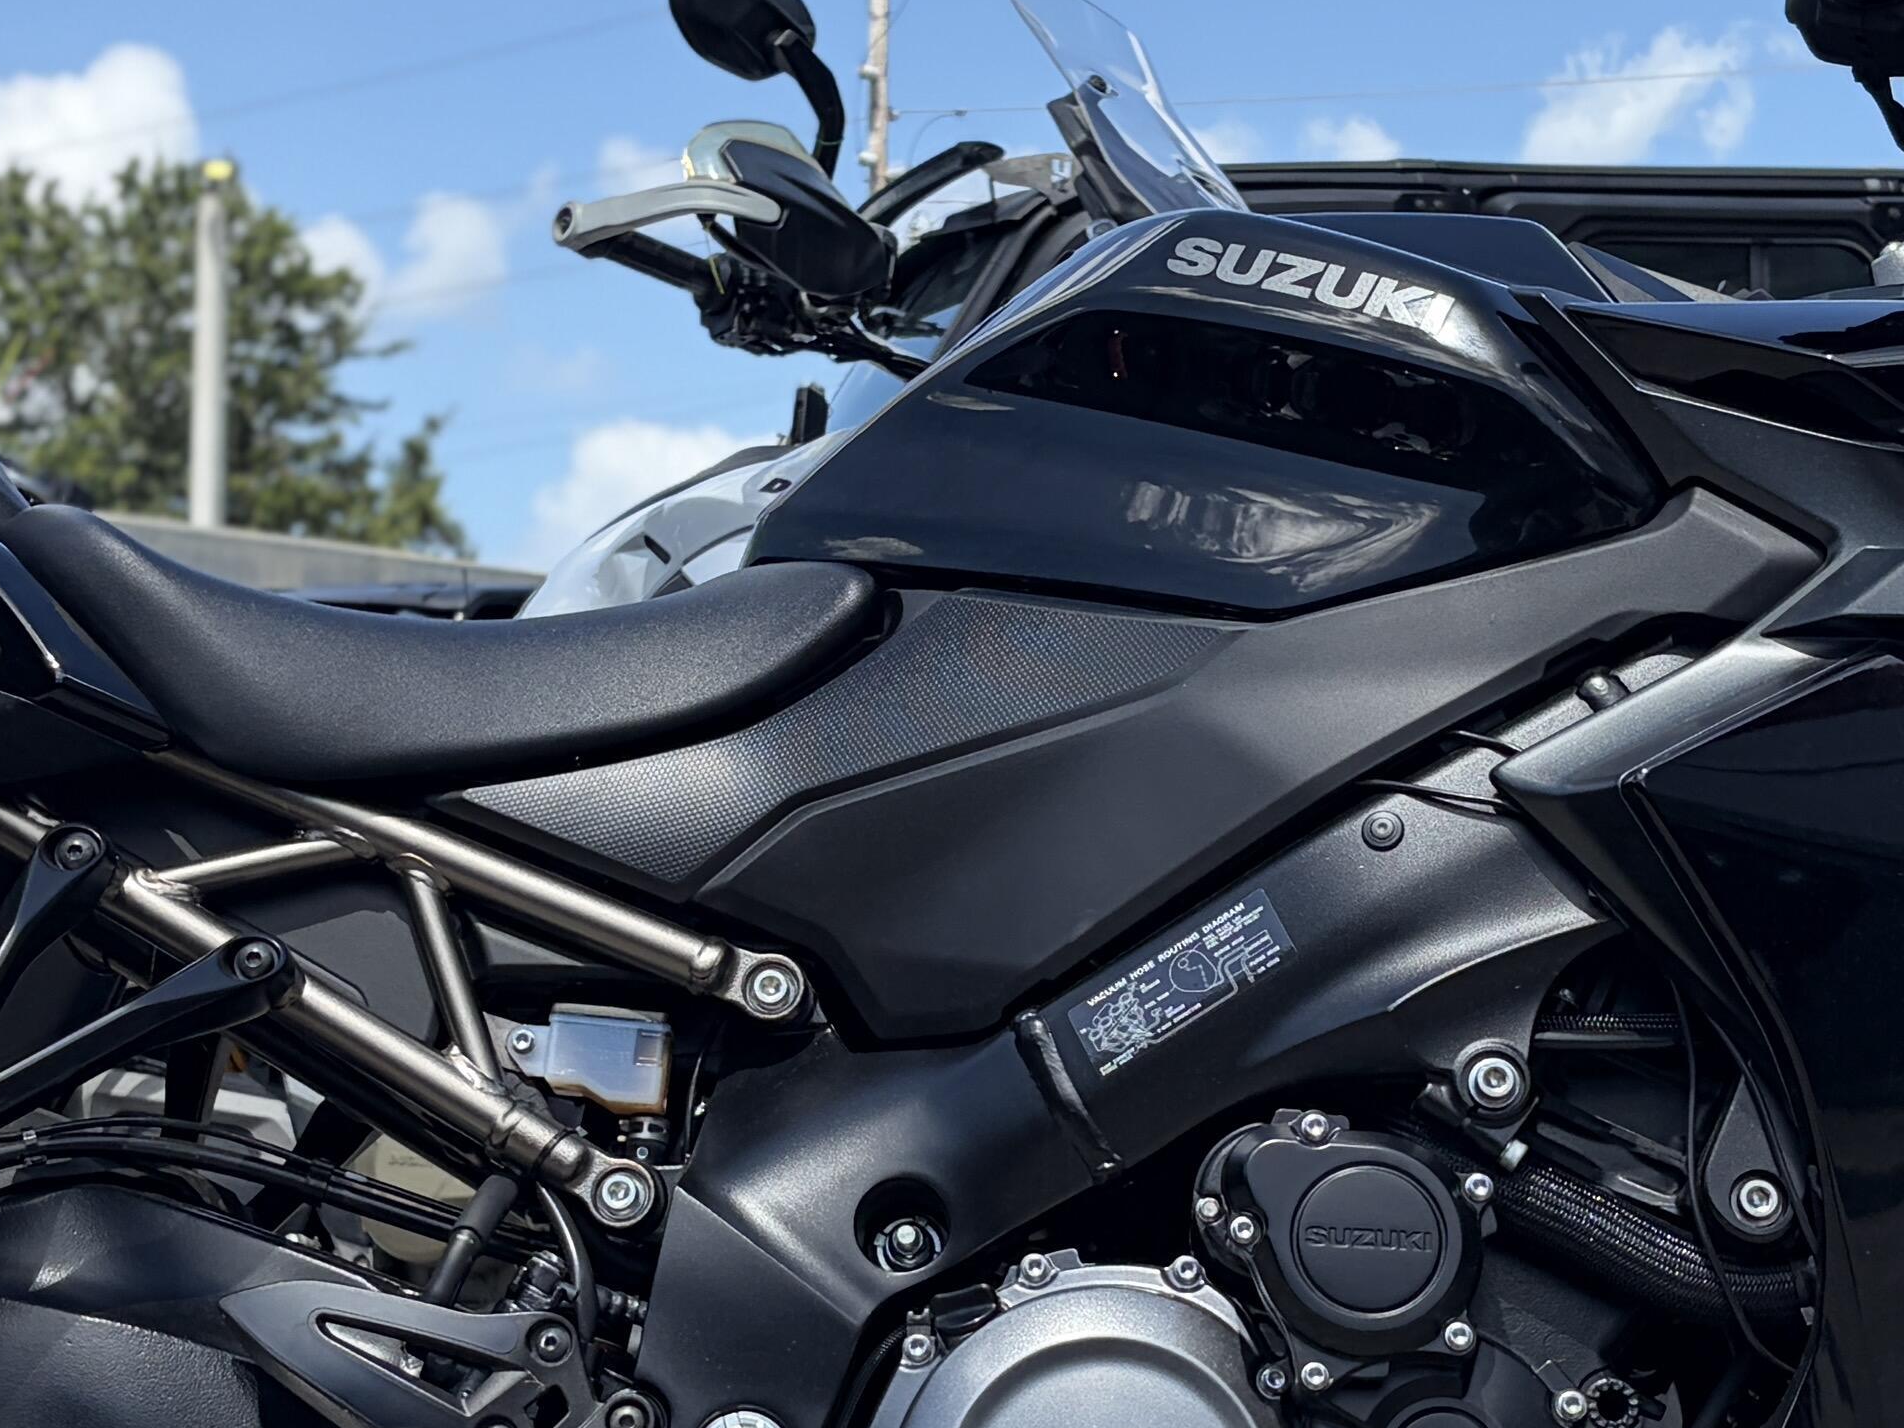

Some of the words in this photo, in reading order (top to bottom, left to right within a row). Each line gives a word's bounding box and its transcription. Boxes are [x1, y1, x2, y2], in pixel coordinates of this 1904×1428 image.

[1167, 236, 1455, 335] SUZUKI
[1086, 977, 1128, 1007] VACUUM
[1130, 960, 1156, 980] HOSE
[1157, 931, 1201, 963] ROUTING
[1202, 902, 1246, 934] DIAGRAM
[1304, 1224, 1433, 1254] SUZUKI
